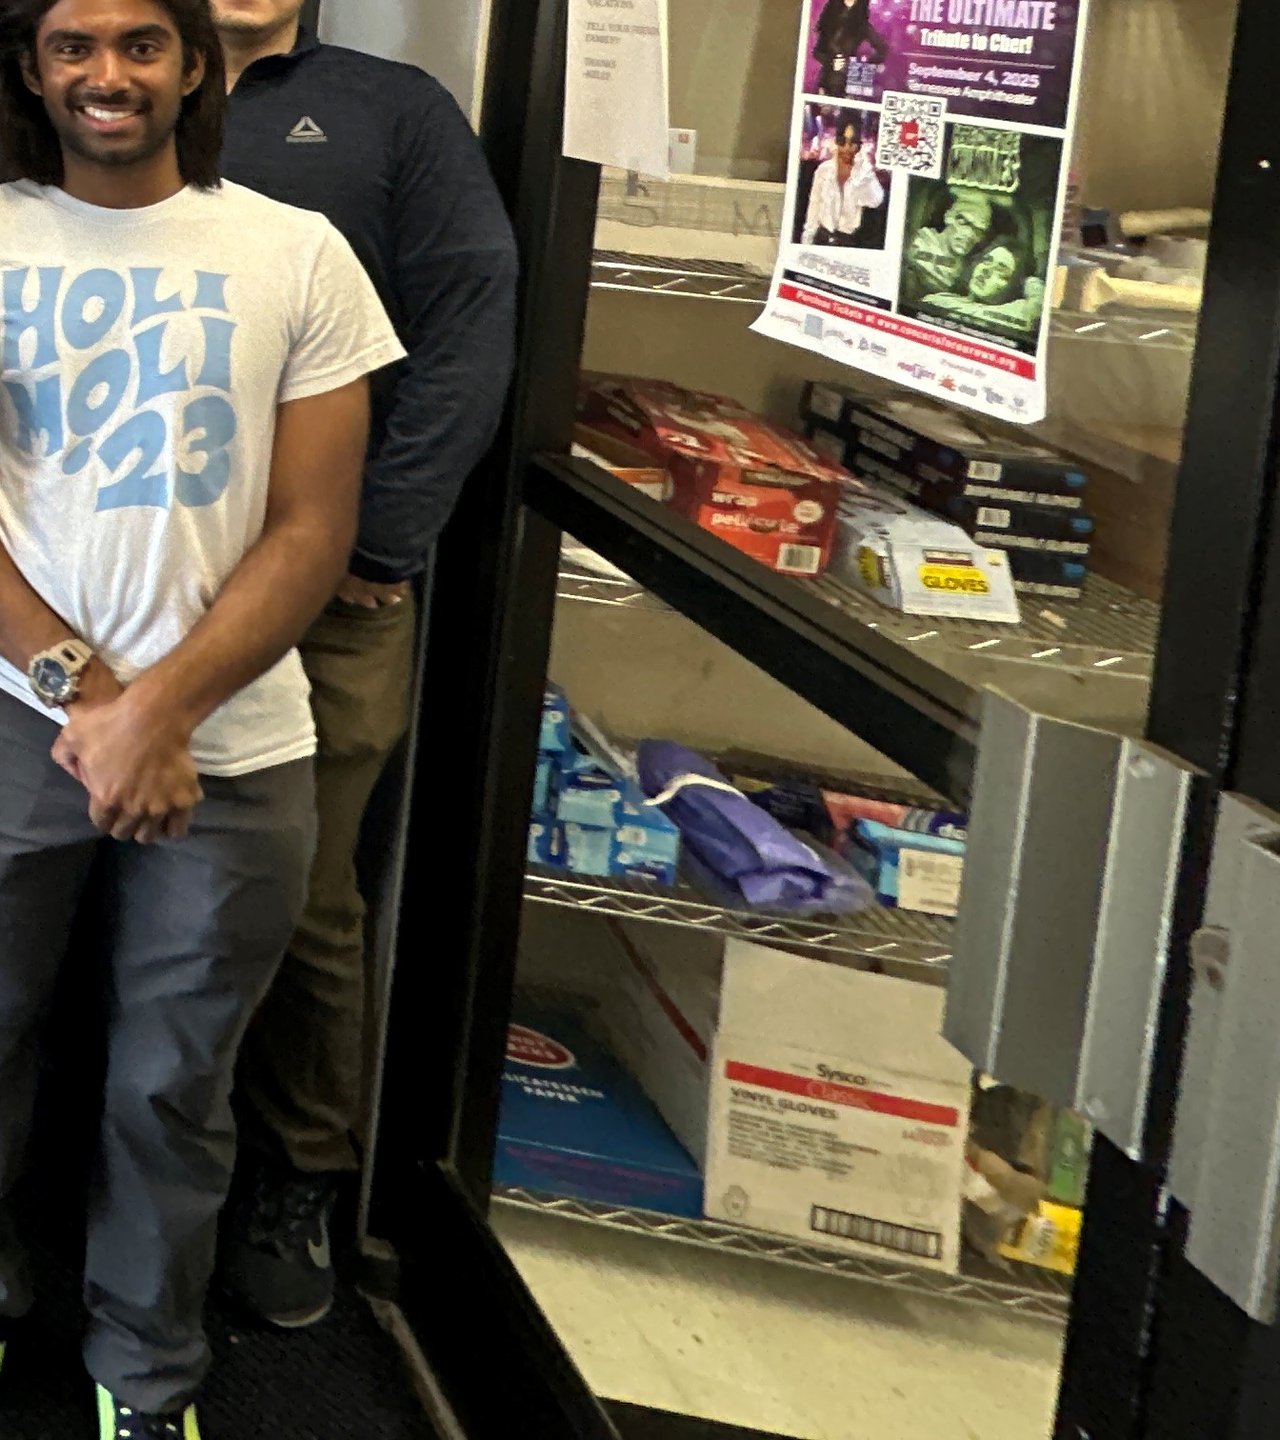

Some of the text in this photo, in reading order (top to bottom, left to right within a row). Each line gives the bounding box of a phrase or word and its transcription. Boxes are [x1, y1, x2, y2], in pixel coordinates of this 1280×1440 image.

[971, 33, 988, 51] to
[990, 33, 1034, 55] Cher!
[908, 62, 1040, 89] September 4, 2025
[2, 266, 230, 372] HOLI
[921, 574, 990, 594] GLOVES
[814, 1062, 868, 1087] Sysco
[729, 1085, 774, 1107] VINYL
[777, 1097, 839, 1120] GLOVES
